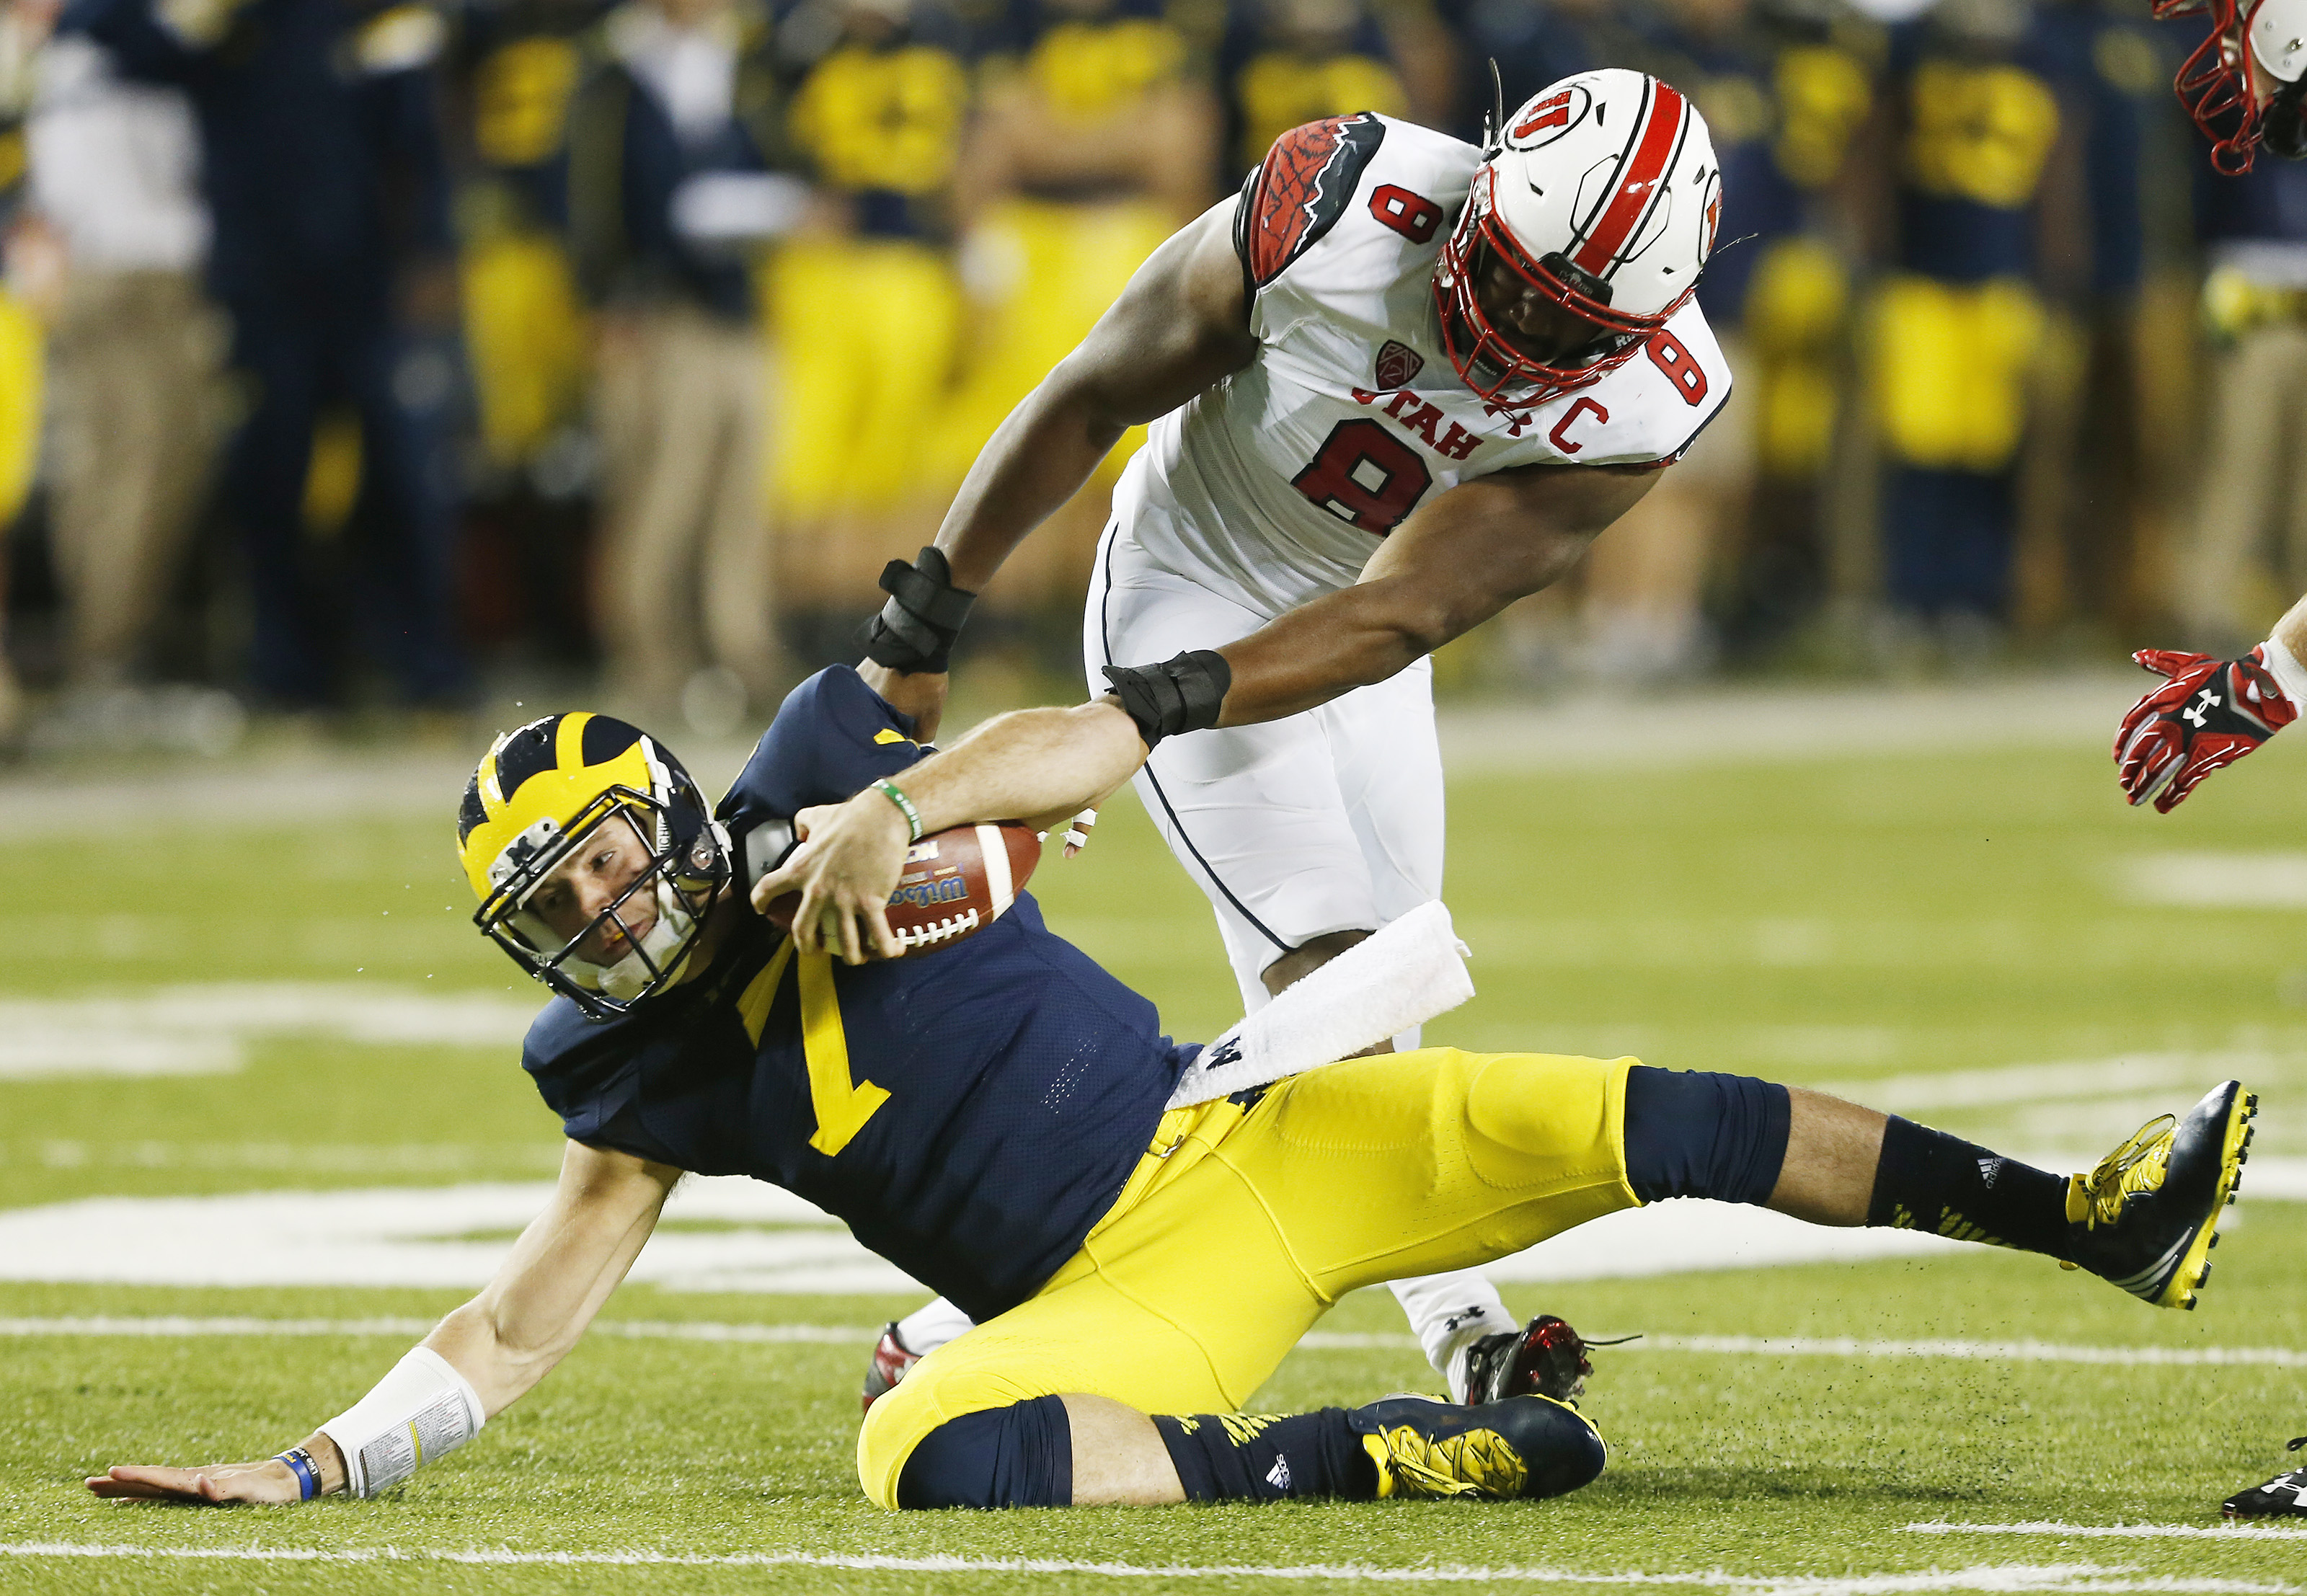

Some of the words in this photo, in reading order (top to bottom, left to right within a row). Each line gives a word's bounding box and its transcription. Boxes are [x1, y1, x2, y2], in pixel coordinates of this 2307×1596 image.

[1368, 183, 1443, 244] 8
[1645, 329, 1709, 407] 8
[1549, 396, 1609, 455] C
[887, 877, 969, 909] Wilso
